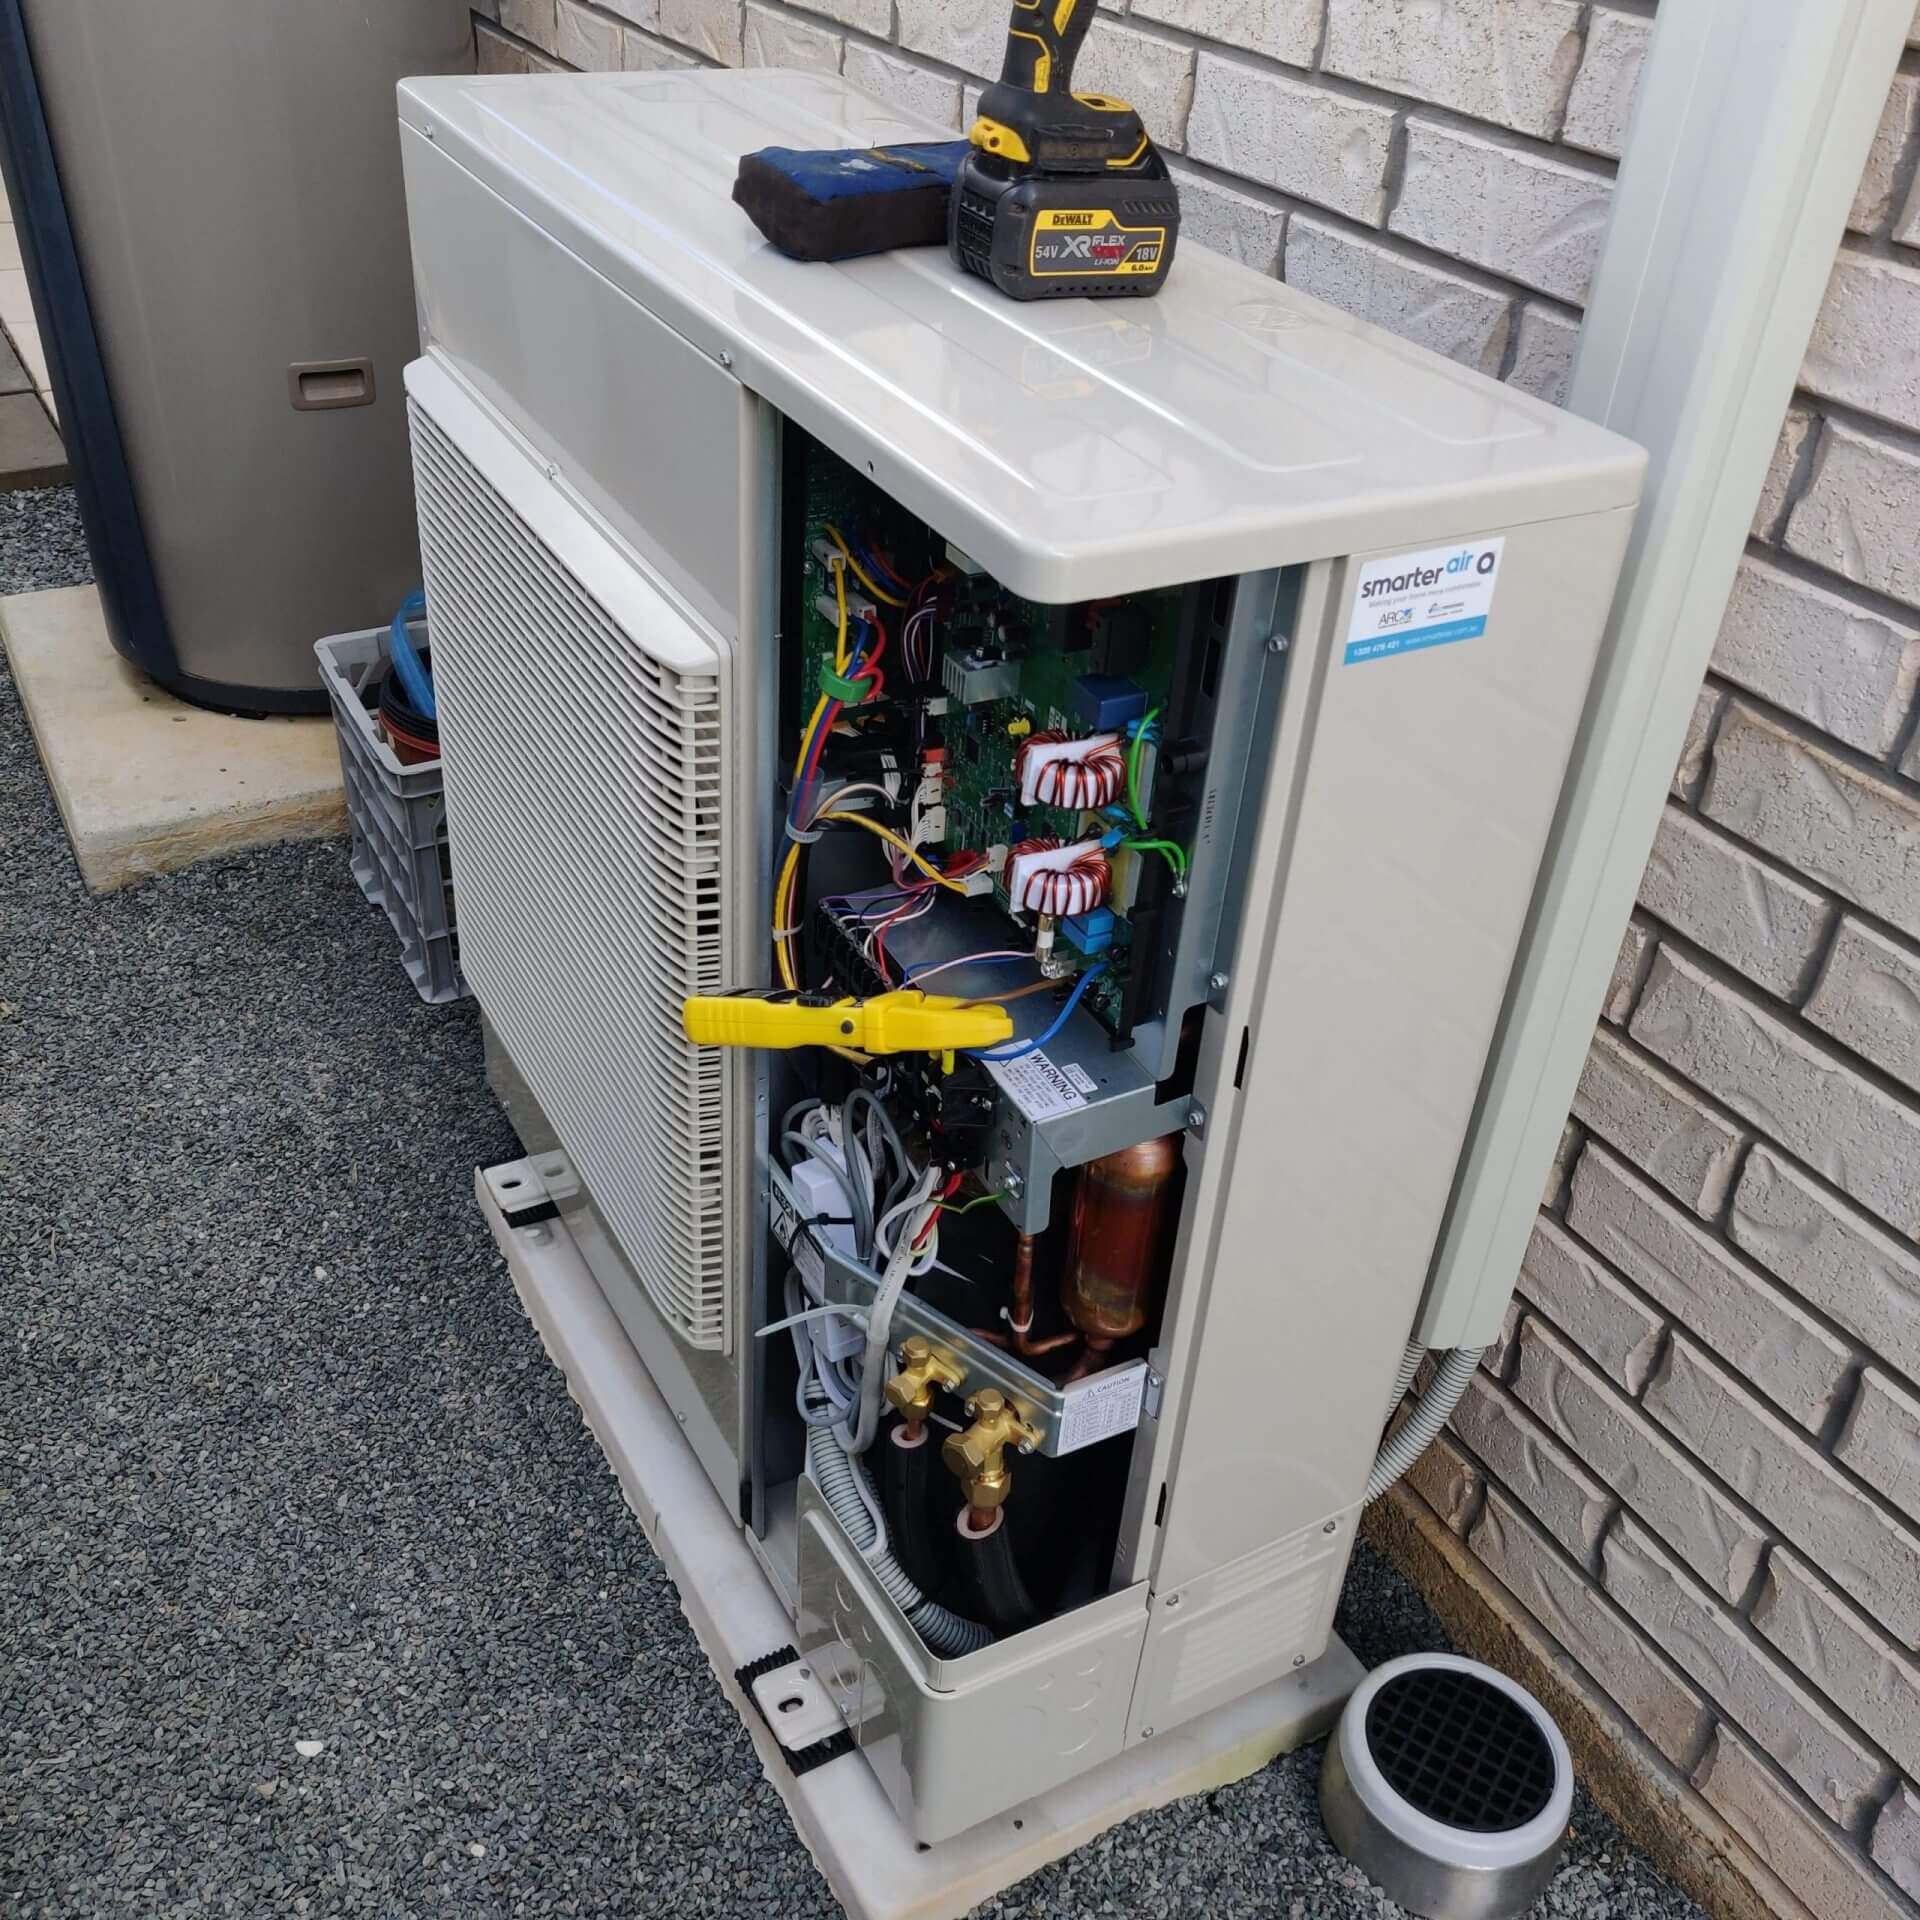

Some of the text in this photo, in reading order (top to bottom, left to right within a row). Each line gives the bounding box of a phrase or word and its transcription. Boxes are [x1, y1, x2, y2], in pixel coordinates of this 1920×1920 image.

[1036, 246, 1058, 258] 54V
[1060, 235, 1091, 258] XR
[1092, 235, 1126, 246] FLEX
[1136, 247, 1158, 260] 18V
[1361, 566, 1443, 598] smarter
[1446, 550, 1473, 574] air
[1030, 1053, 1077, 1101] WARNING
[1097, 1376, 1131, 1393] CAUTION
